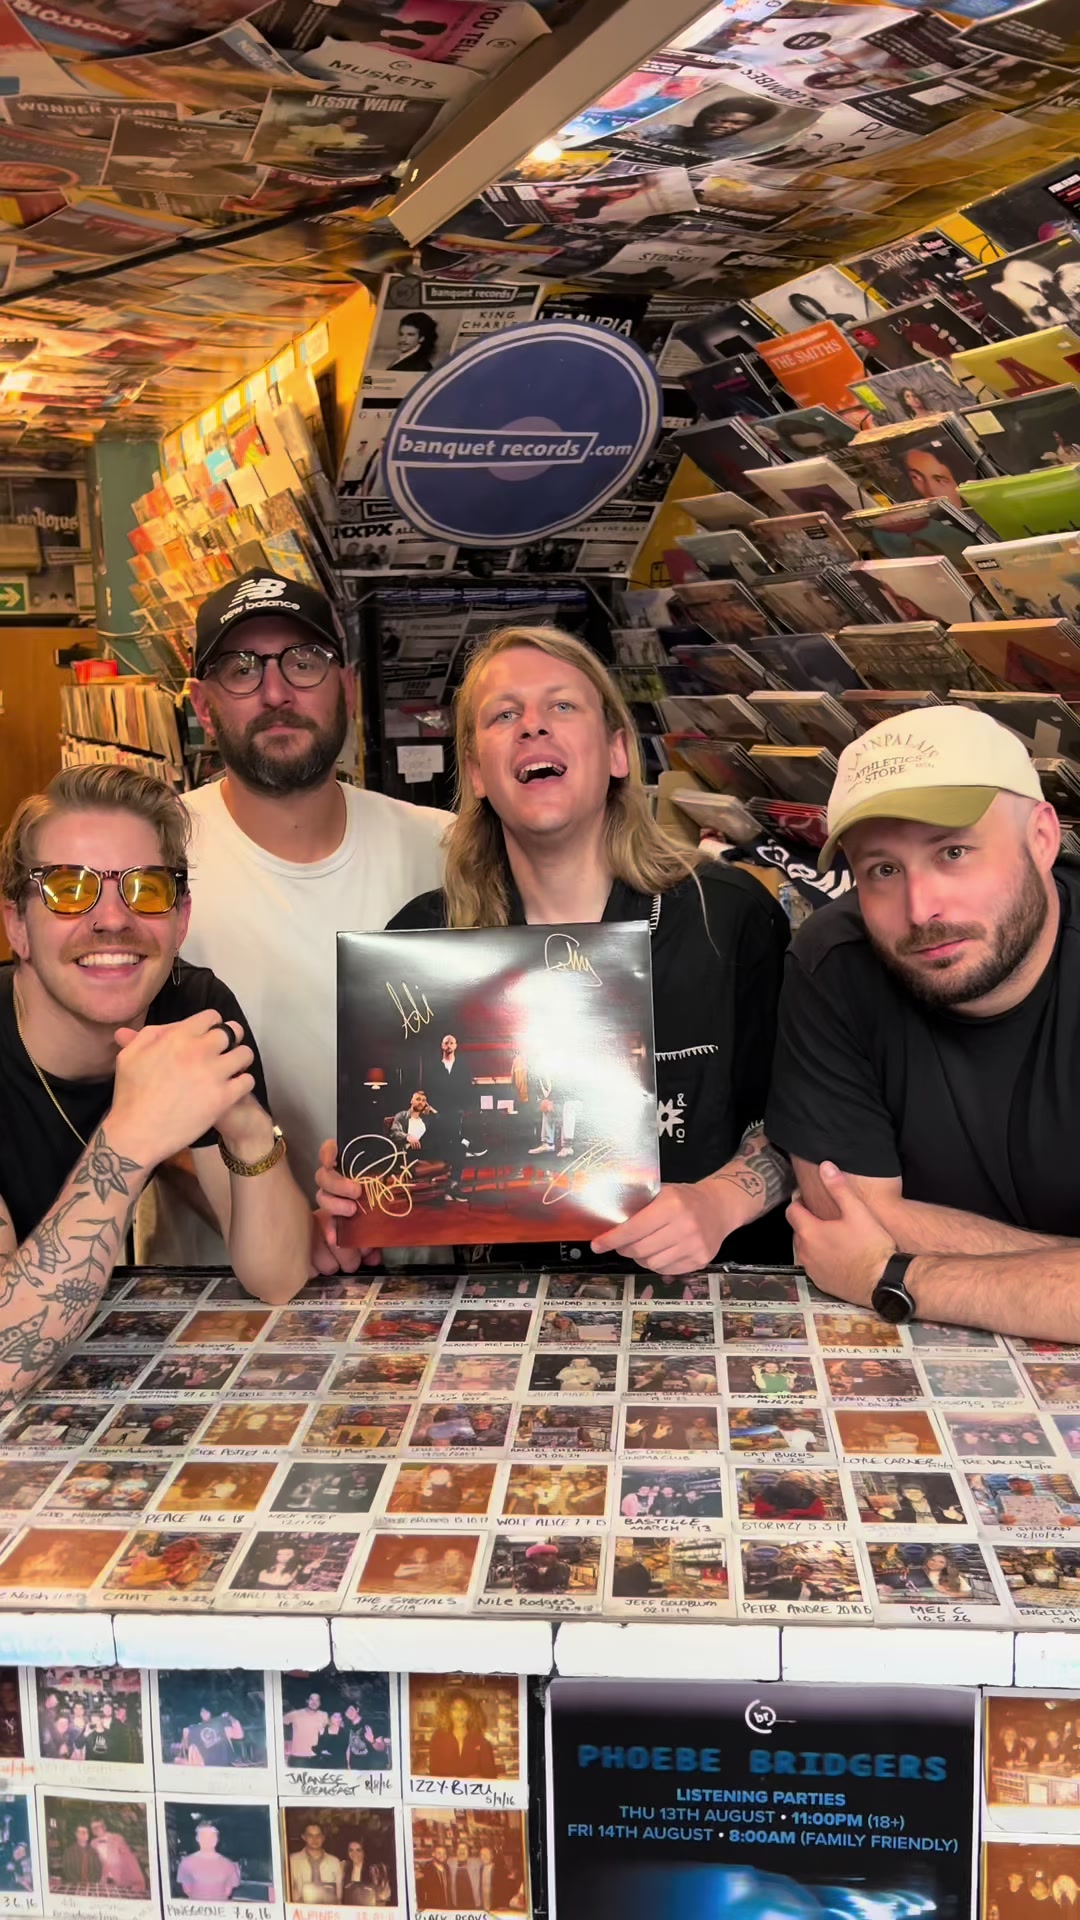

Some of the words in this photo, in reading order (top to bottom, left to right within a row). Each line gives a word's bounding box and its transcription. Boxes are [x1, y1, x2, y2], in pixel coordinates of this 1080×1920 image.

[328, 59, 437, 90] MUSKETS
[17, 101, 102, 115] WONDER
[109, 106, 176, 119] YEARS
[306, 94, 360, 110] JESSIE
[363, 97, 410, 113] WARE
[430, 286, 473, 302] banquet
[475, 288, 512, 299] records
[479, 310, 516, 320] KING
[771, 354, 794, 371] THE
[793, 339, 842, 365] SMITHS
[398, 434, 495, 460] banquet
[500, 438, 580, 457] records
[588, 441, 633, 457] .com
[219, 605, 245, 625] new
[245, 599, 301, 611] balance
[855, 754, 923, 781] ATHLETICS
[864, 764, 906, 784] STORE
[884, 1458, 934, 1466] CARNER
[145, 1513, 189, 1525] PEACE
[496, 1518, 529, 1527] WOLF
[536, 1518, 569, 1527] ALICE
[624, 1518, 701, 1526] BASTILLE
[741, 1522, 802, 1531] STORMZY
[10, 1592, 49, 1601] Nash
[103, 1593, 153, 1601] CMAT
[389, 1597, 458, 1605] SPECIALS
[519, 1597, 576, 1609] Rodgers
[624, 1599, 655, 1607] JEFF
[741, 1602, 780, 1614] PETER
[787, 1603, 833, 1615] ANDRE
[909, 1606, 946, 1614] MEL
[953, 1606, 965, 1614] C
[1020, 1609, 1075, 1617] ENGLISH
[952, 1615, 972, 1623] 26
[578, 1744, 722, 1773] PHOEBE
[749, 1749, 948, 1782] BRIDGERS
[285, 1772, 345, 1787] JAPANESE
[676, 1788, 768, 1804] LISTENING
[773, 1791, 847, 1807] PARTIES
[619, 1805, 655, 1820] THU
[660, 1807, 700, 1821] 13TH
[704, 1809, 776, 1824] AUGUST
[791, 1811, 864, 1828] 11:00PM
[867, 1813, 905, 1831] (18+)
[567, 1824, 593, 1837] FRI
[598, 1825, 638, 1839] 14TH
[642, 1826, 714, 1841] AUGUST
[728, 1829, 796, 1844] 8:00AM
[800, 1831, 867, 1847] (FAMILY
[871, 1834, 959, 1854] FRIENDLY)
